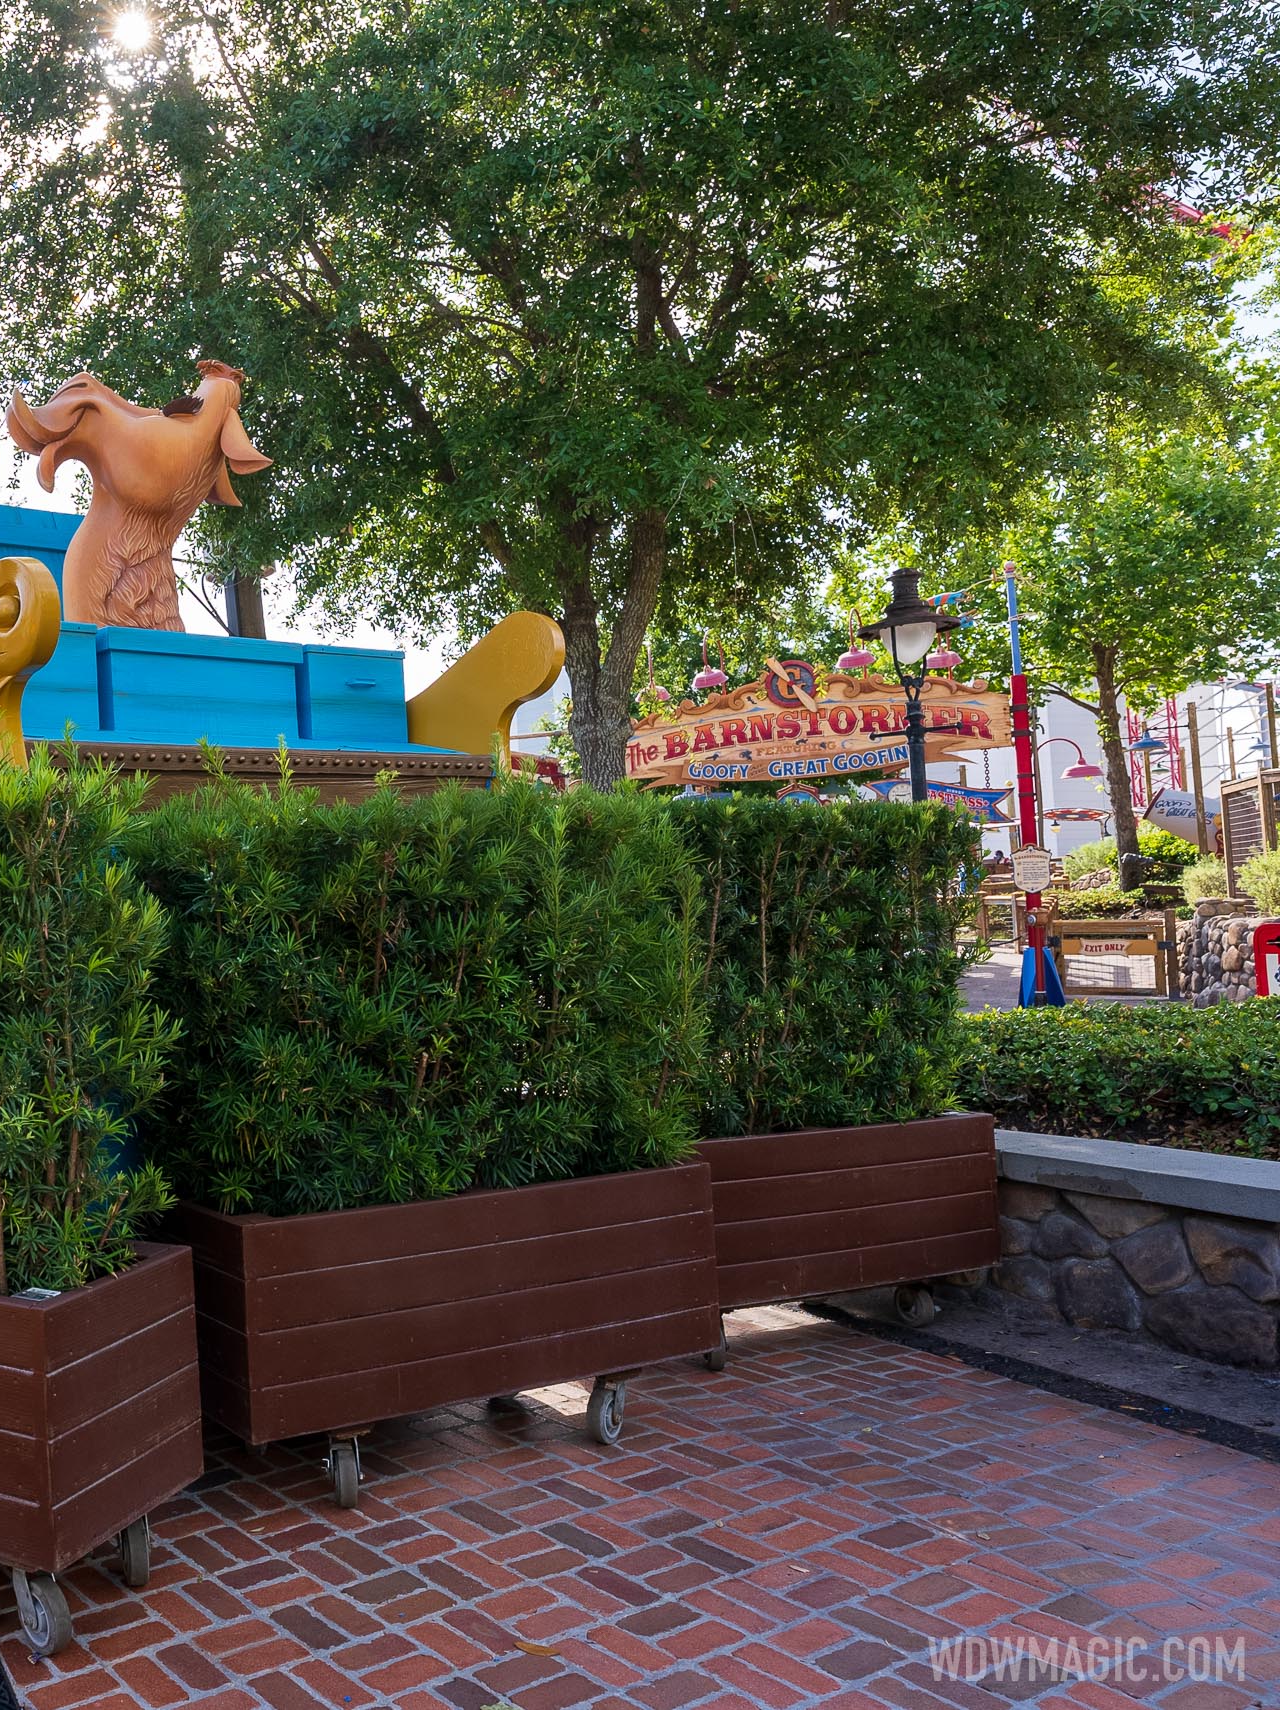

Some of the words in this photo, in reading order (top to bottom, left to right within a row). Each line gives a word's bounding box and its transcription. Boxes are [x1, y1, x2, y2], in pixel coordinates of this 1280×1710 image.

[626, 742, 658, 773] The
[663, 705, 993, 761] BARNSTORMER
[688, 762, 751, 779] GOOFY
[768, 758, 830, 777] GREAT
[832, 745, 909, 771] GOOFIN
[927, 789, 990, 807] ASTPASS+
[1084, 944, 1103, 952] EXIT
[1104, 943, 1125, 951] ONLY
